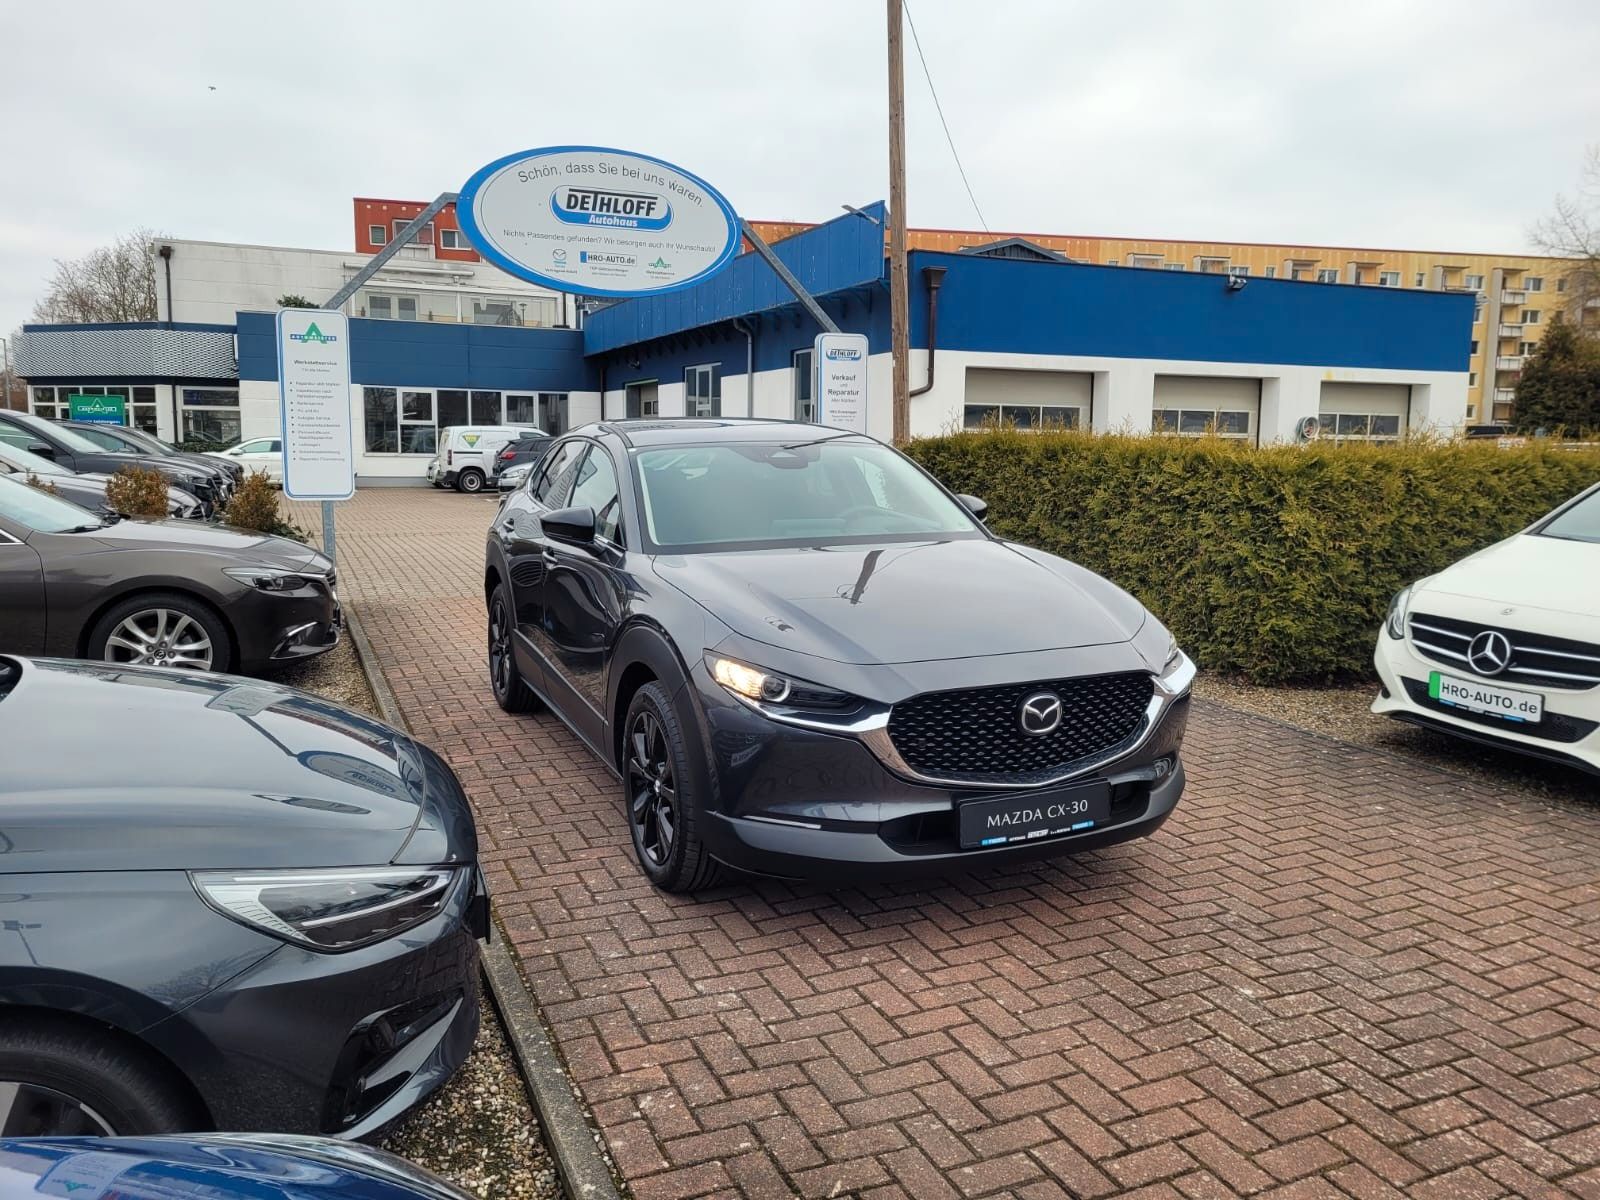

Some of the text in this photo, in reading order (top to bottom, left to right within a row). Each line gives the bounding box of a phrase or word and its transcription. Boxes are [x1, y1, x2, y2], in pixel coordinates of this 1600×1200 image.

[518, 162, 703, 208] Schön, dass Sie bei uns waren.
[566, 188, 658, 217] DETHLOFF
[589, 214, 638, 228] Autohaus
[503, 229, 526, 238] Nichts
[527, 231, 565, 241] Passendes
[566, 234, 602, 244] gefunden?
[604, 237, 615, 245] Wir
[616, 239, 647, 248] besorgen
[587, 253, 636, 265] HRO-AUTO.de
[831, 373, 856, 382] Verkauf
[827, 388, 860, 397] Reparatur
[1441, 681, 1538, 715] HRO-AUTO.de
[987, 799, 1088, 829] MAZDA CX-30
